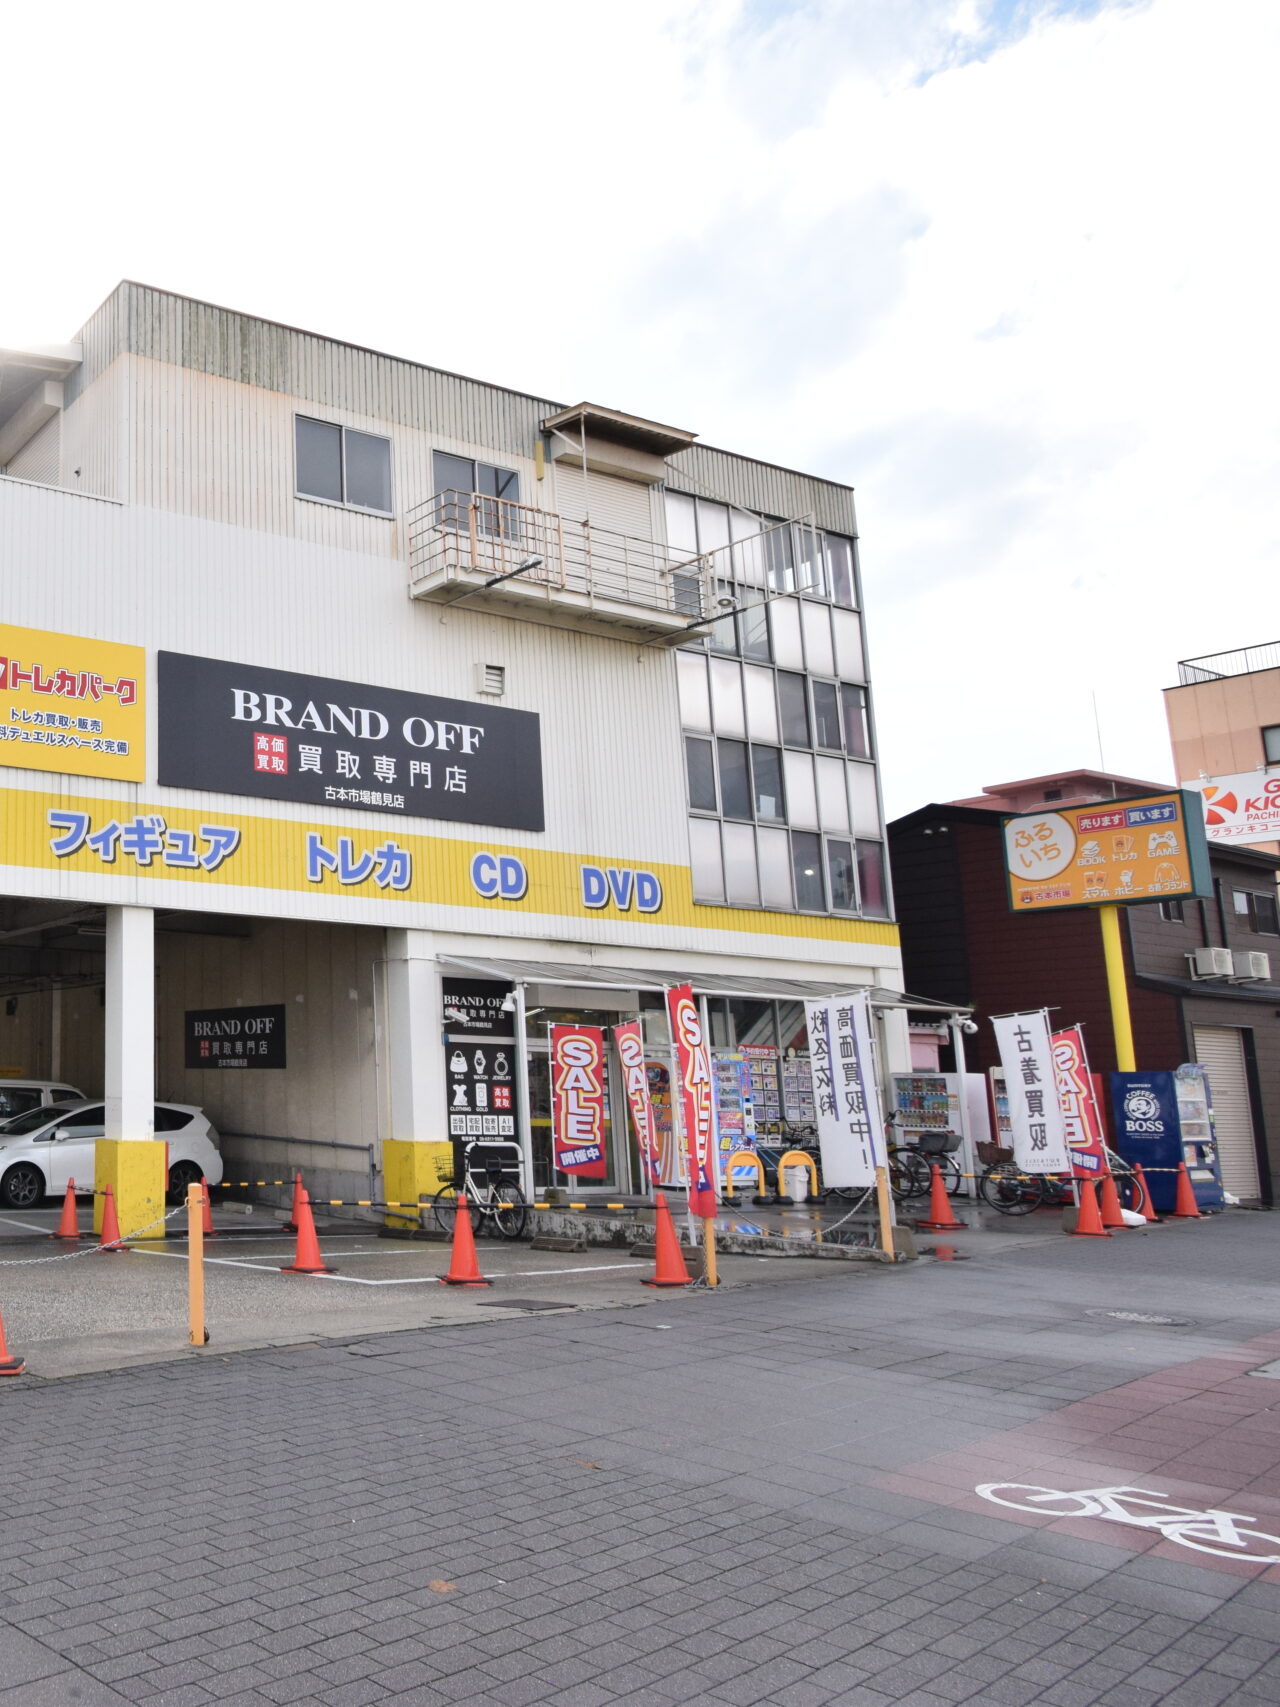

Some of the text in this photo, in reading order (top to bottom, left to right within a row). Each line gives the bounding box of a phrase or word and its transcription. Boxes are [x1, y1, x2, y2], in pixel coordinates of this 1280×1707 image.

[10, 660, 136, 706] トレカパーク
[11, 708, 102, 733] トレカ買取・販売
[230, 688, 485, 754] BRAND OFF
[257, 736, 284, 753] 高価
[257, 754, 285, 772] 買取
[298, 744, 468, 794] 買取専門店
[324, 785, 405, 809] 古本市場鶴見店
[1081, 814, 1122, 830] 売ります
[1128, 806, 1173, 822] 買います
[48, 810, 240, 869] フィギュア
[1015, 822, 1053, 848] ふる
[307, 832, 412, 890] トレカ
[1020, 843, 1061, 868] いち
[1077, 856, 1106, 866] BOOK
[1112, 853, 1138, 862] トレカ
[1147, 847, 1181, 858] GAME
[472, 852, 528, 899] CD
[582, 865, 662, 912] DVD
[1083, 886, 1109, 898] スマホ
[1114, 887, 1144, 896] ホビー
[444, 995, 503, 1008] BRAND OF
[194, 1017, 274, 1036] BRAND OFF
[562, 1040, 596, 1140] SALE
[1126, 1090, 1156, 1099] COFFEE
[1125, 1120, 1165, 1132] BOSS
[560, 1147, 600, 1166] 開催中
